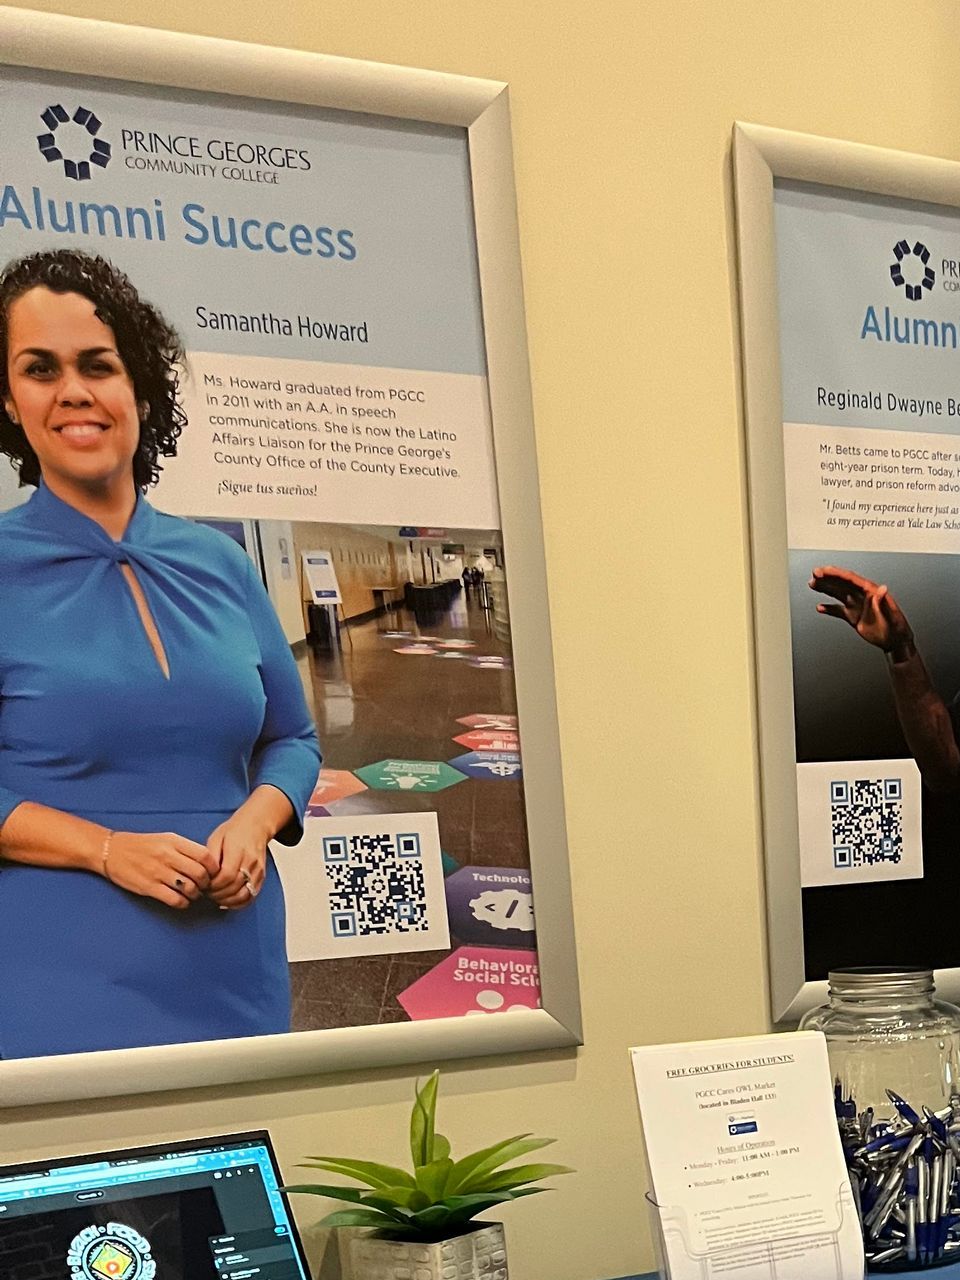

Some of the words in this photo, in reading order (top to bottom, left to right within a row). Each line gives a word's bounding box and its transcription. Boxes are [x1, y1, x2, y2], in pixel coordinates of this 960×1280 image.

[121, 129, 202, 159] PRINCE
[206, 138, 312, 172] GEORGE'S
[125, 156, 217, 179] COMMUNITY
[221, 165, 280, 185] COLLEGE
[0, 183, 166, 242] Alumni
[183, 202, 358, 261] Success
[196, 306, 292, 337] Samantha
[298, 316, 369, 344] Howard
[230, 376, 281, 392] Howard
[285, 381, 351, 397] graduated
[355, 385, 385, 400] from
[389, 389, 425, 403] PGCC
[817, 387, 882, 411] Reginald
[887, 393, 942, 417] Dwayne
[206, 393, 218, 406] in
[223, 395, 250, 408] 2011
[253, 397, 282, 411] with
[286, 402, 302, 413] an
[306, 401, 333, 415] A.A.
[336, 403, 348, 416] in
[352, 405, 396, 420] speech
[209, 414, 320, 433] communications.
[324, 421, 348, 435] She
[352, 423, 362, 436] is
[366, 426, 391, 438] now
[395, 426, 416, 440] the
[419, 428, 457, 442] Latino
[212, 432, 254, 447] Affairs
[259, 435, 304, 451] Liaison
[309, 438, 325, 452] for
[331, 440, 351, 453] the
[355, 442, 394, 456] Prince
[398, 445, 451, 461] George's
[836, 445, 861, 457] Betts
[863, 449, 888, 458] came
[891, 449, 900, 459] to
[903, 449, 929, 460] PGCC
[931, 451, 952, 461] after
[214, 451, 261, 468] County
[266, 454, 305, 469] Office
[309, 457, 322, 470] of
[327, 458, 347, 472] the
[350, 460, 395, 477] County
[400, 463, 460, 478] Executive.
[820, 462, 868, 475] eight-year
[871, 464, 899, 475] prison
[928, 466, 955, 479] Today,
[256, 482, 274, 495] tus
[276, 483, 318, 497] sueños!
[821, 477, 852, 490] lawyer,
[855, 478, 873, 488] and
[876, 480, 903, 492] prison
[906, 480, 936, 491] reform
[832, 500, 856, 511] found
[858, 504, 871, 514] my
[873, 503, 914, 516] experience
[916, 503, 932, 514] here
[934, 505, 949, 517] just
[950, 507, 959, 515] as
[827, 517, 836, 526] as
[838, 518, 851, 529] my
[852, 518, 895, 530] experience
[907, 518, 923, 528] Yale
[925, 518, 942, 528] Law
[453, 970, 504, 985] Social
[666, 1068, 687, 1078] FREE
[688, 1063, 735, 1075] GROCERIES
[736, 1060, 751, 1068] FOR
[695, 1089, 716, 1098] PGCC
[717, 1087, 734, 1096] Cares
[736, 1085, 753, 1094] OWL
[754, 1082, 776, 1091] Market
